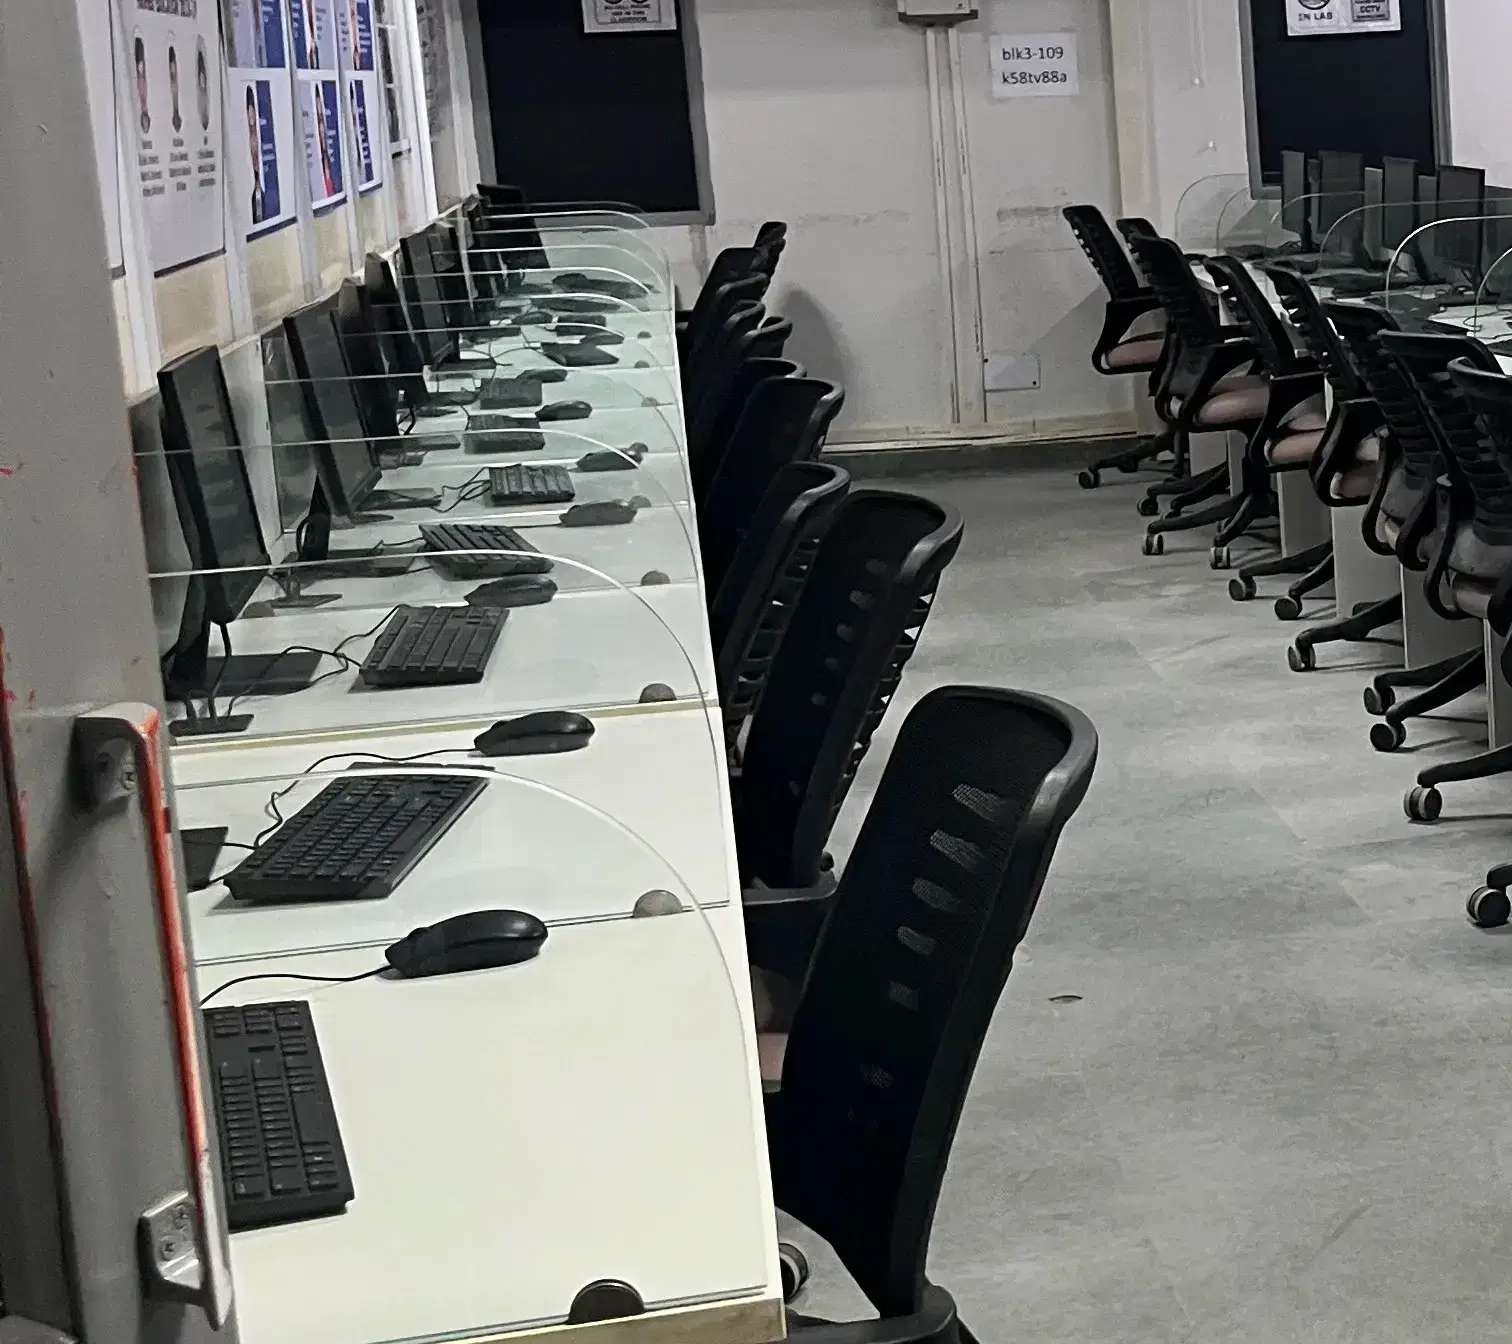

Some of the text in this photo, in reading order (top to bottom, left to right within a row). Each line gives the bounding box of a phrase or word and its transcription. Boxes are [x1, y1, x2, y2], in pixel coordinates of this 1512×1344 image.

[1360, 5, 1380, 13] CCTV
[1314, 12, 1333, 20] LAB
[1002, 46, 1064, 61] blk3-109
[1002, 70, 1067, 85] k58tv88a
